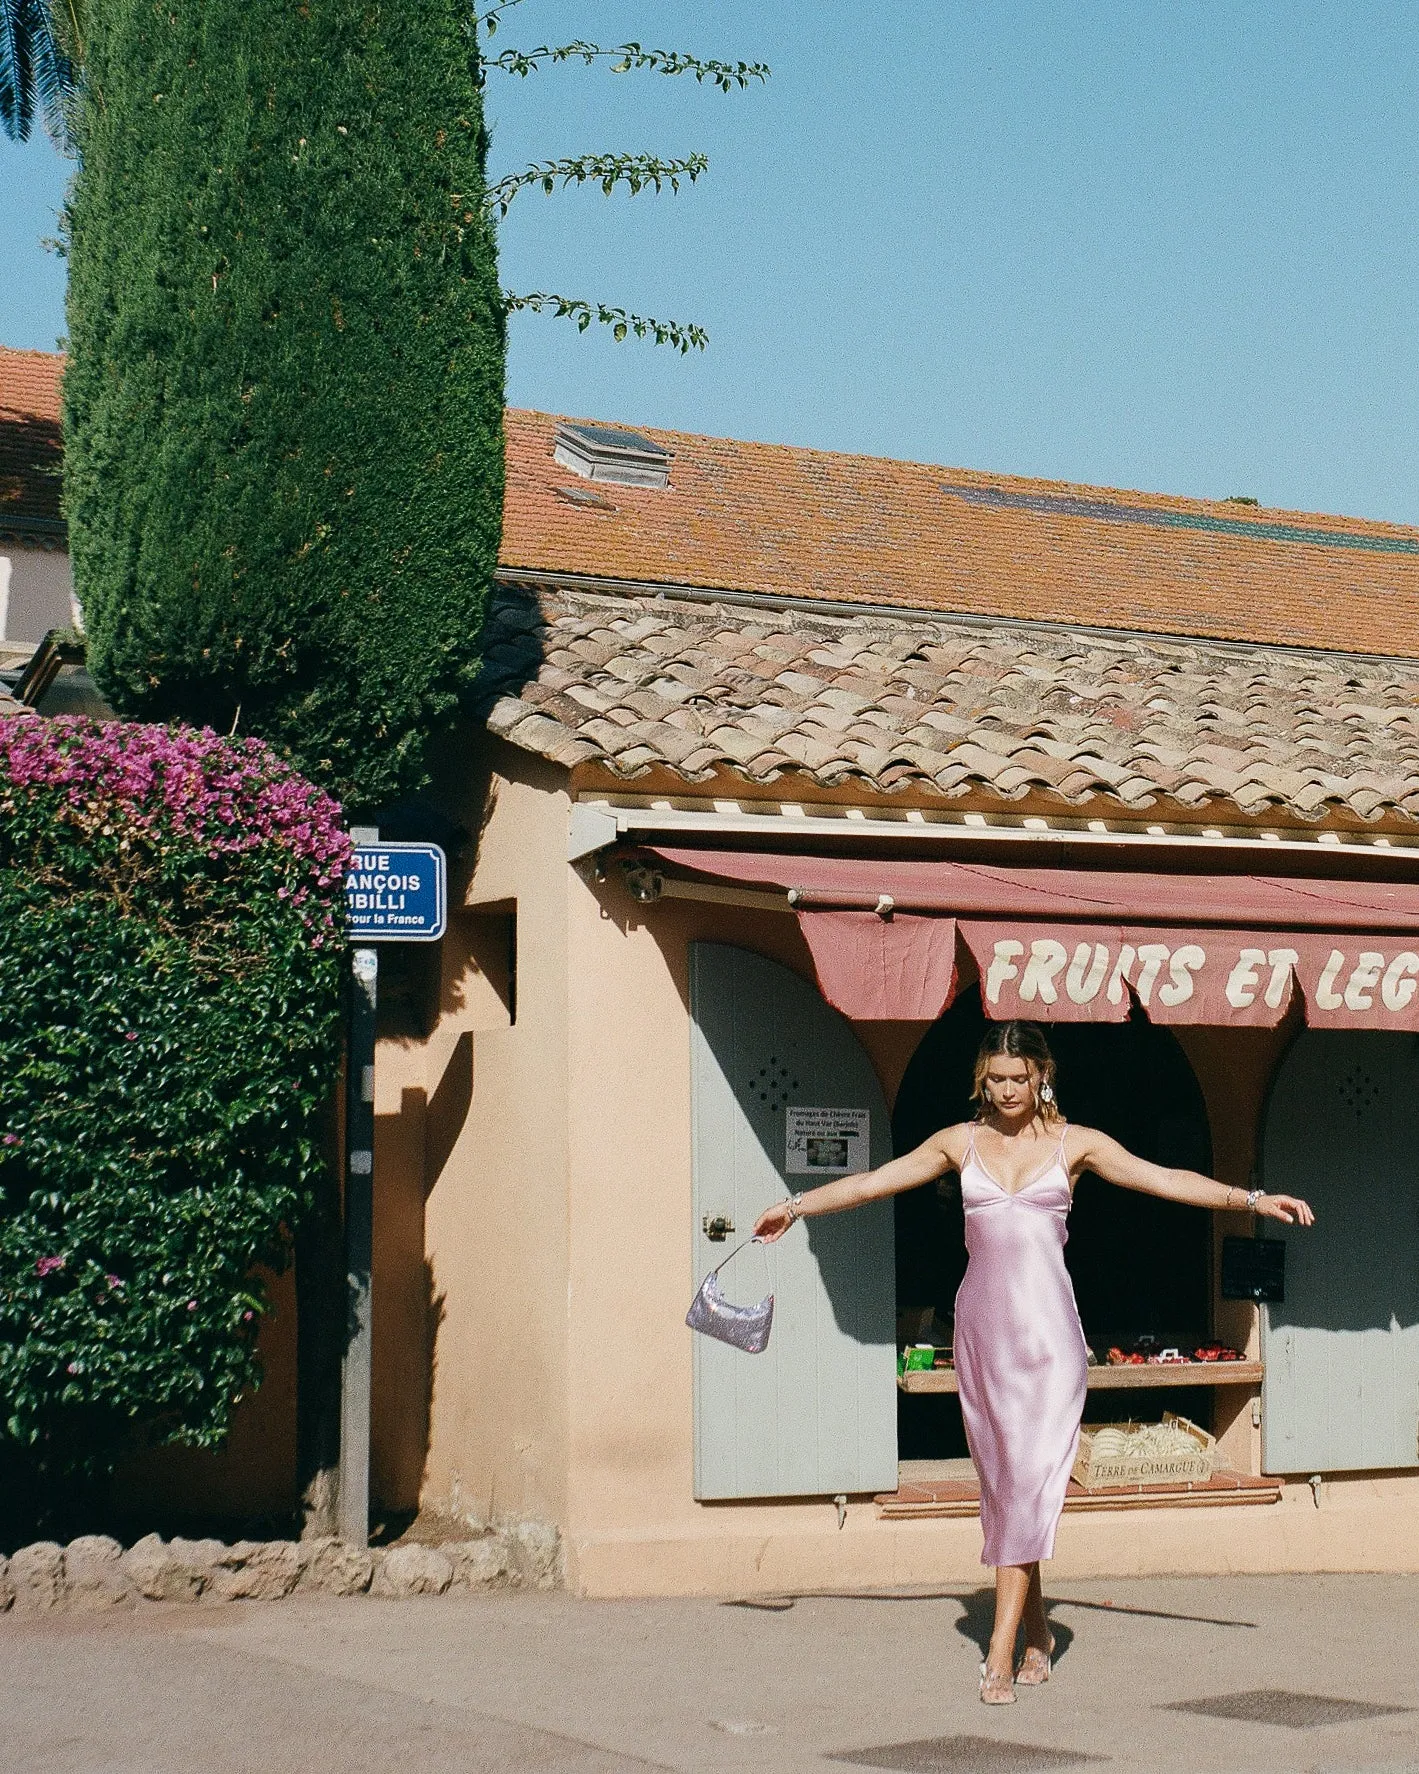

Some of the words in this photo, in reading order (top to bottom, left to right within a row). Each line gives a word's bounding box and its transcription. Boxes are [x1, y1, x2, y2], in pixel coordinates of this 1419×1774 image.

[351, 855, 390, 871] RUE
[345, 874, 420, 894] ANÇOIS
[348, 894, 405, 909] IBILLI
[374, 914, 385, 924] la
[387, 914, 425, 925] France
[985, 939, 1206, 1006] FRUITS
[1226, 948, 1299, 1009] ET
[1315, 949, 1419, 1012] LEG
[789, 1110, 820, 1118] Fromages
[1094, 1463, 1126, 1478] TERRE
[1140, 1461, 1196, 1475] CAMARGUE
